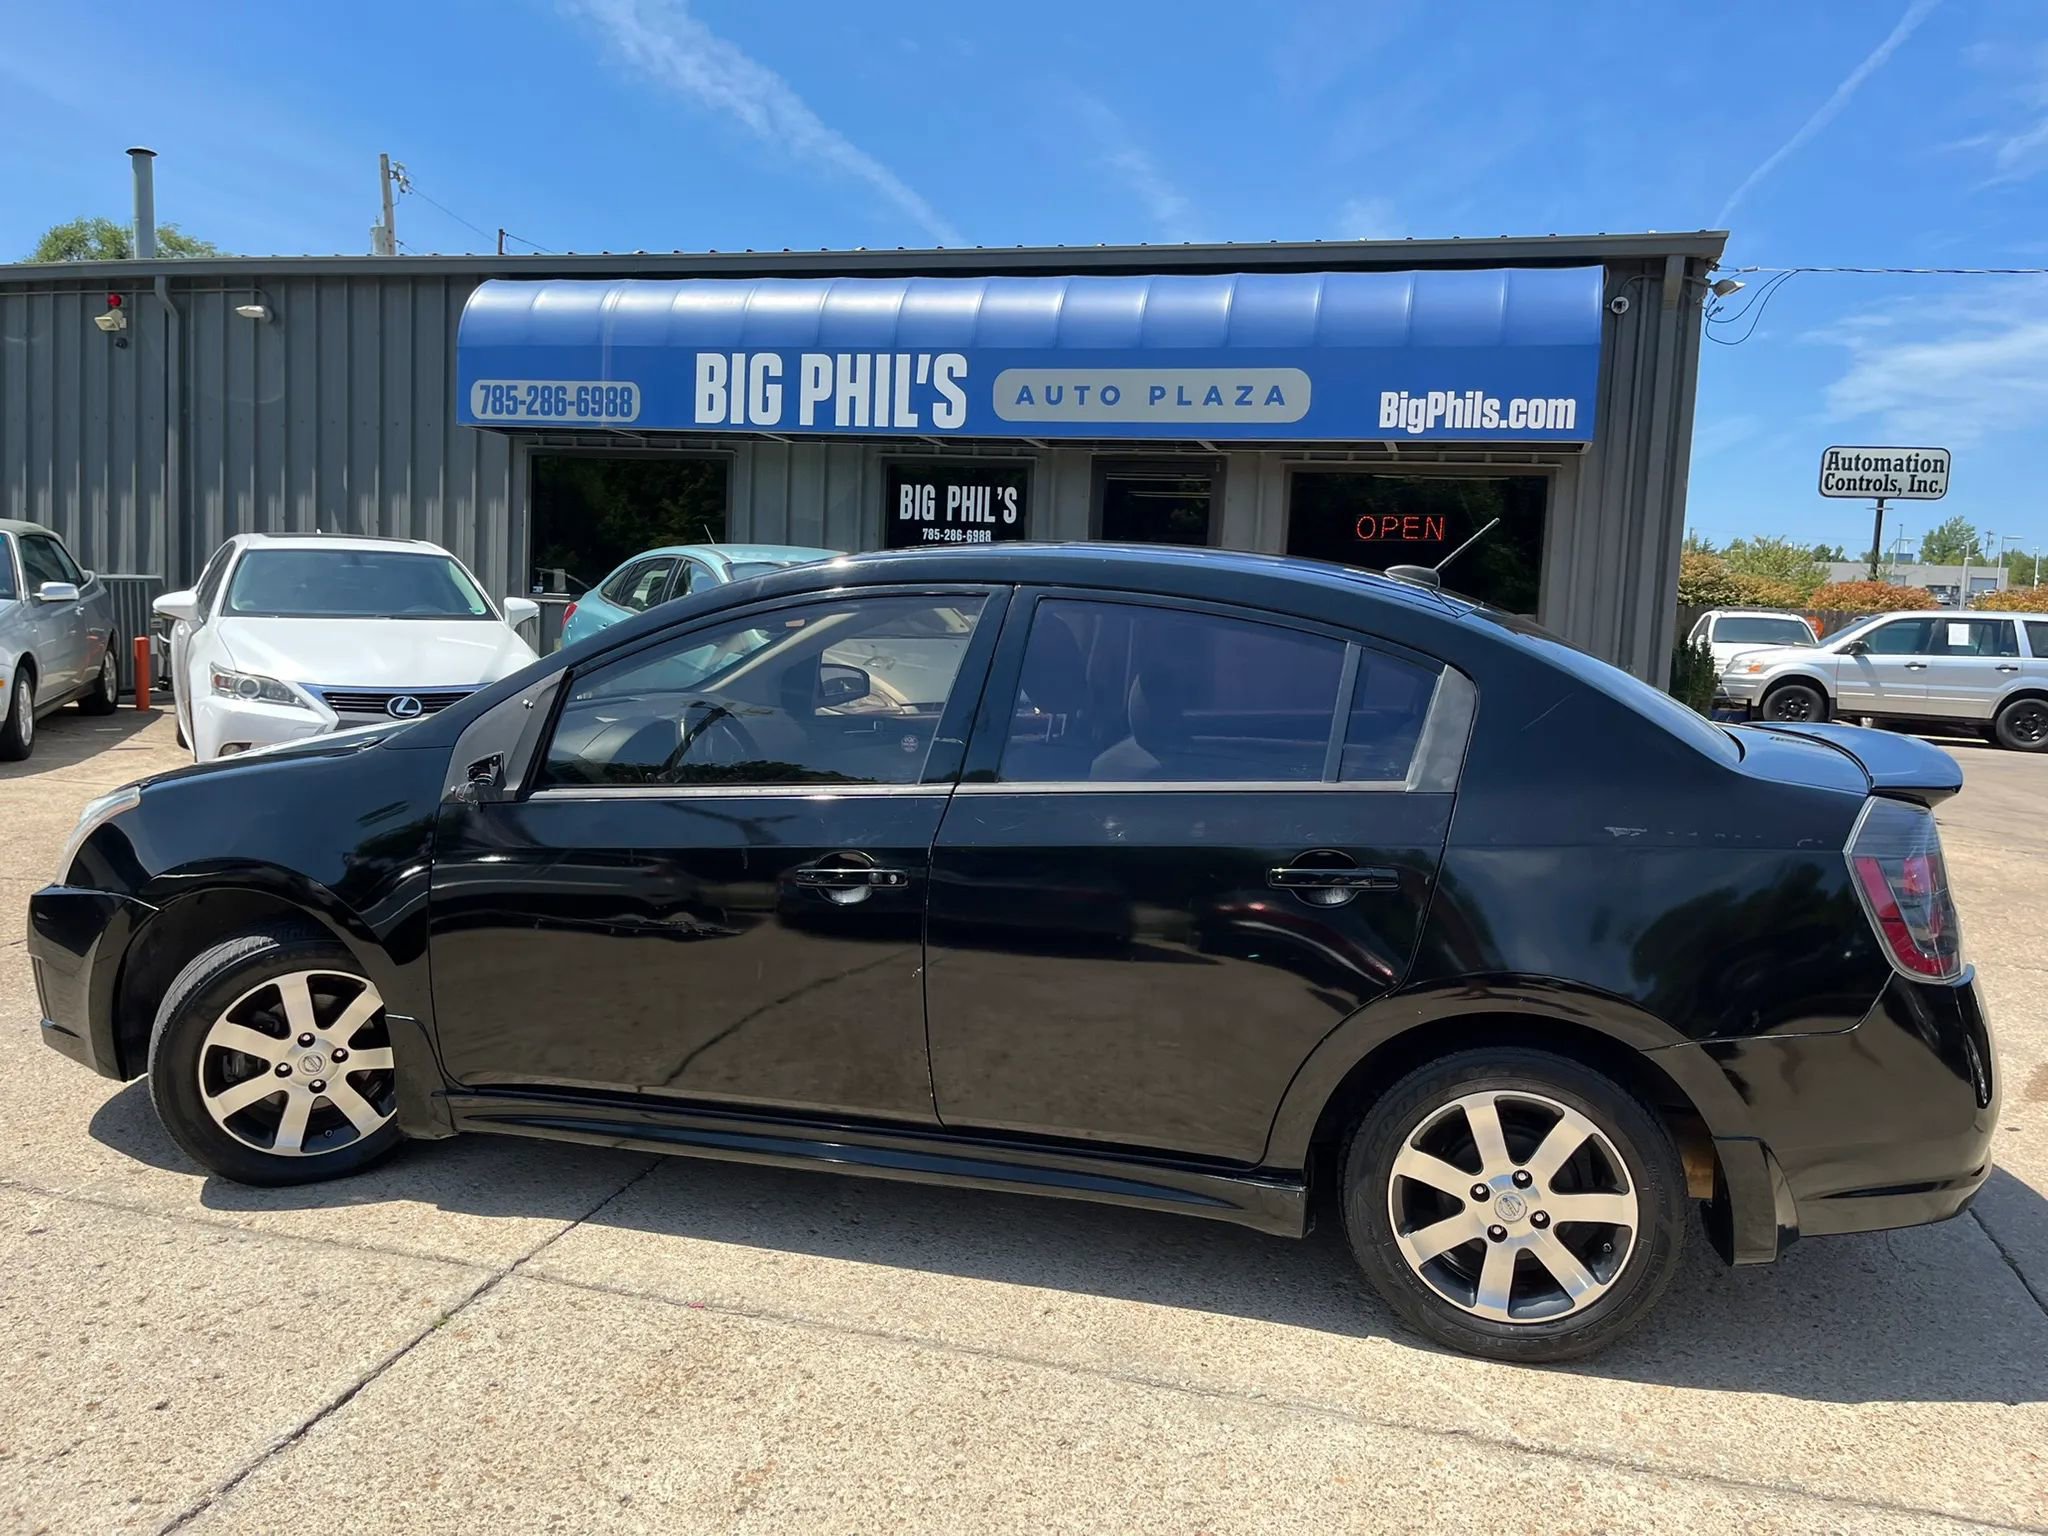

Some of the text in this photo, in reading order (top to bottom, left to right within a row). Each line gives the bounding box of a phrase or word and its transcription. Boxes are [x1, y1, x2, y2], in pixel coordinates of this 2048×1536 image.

[480, 383, 634, 418] 785-286-6988
[695, 352, 968, 429] BIG PHIL'S
[1015, 385, 1287, 407] AUTO PLAZA
[1379, 391, 1577, 434] BigPhils.com
[1825, 451, 1945, 473] Automation
[1824, 473, 1943, 496] Controls, Inc.
[900, 484, 1017, 523] BIG PHIL'S
[922, 528, 991, 542] 785-286-6988
[1357, 516, 1444, 540] OPEN
